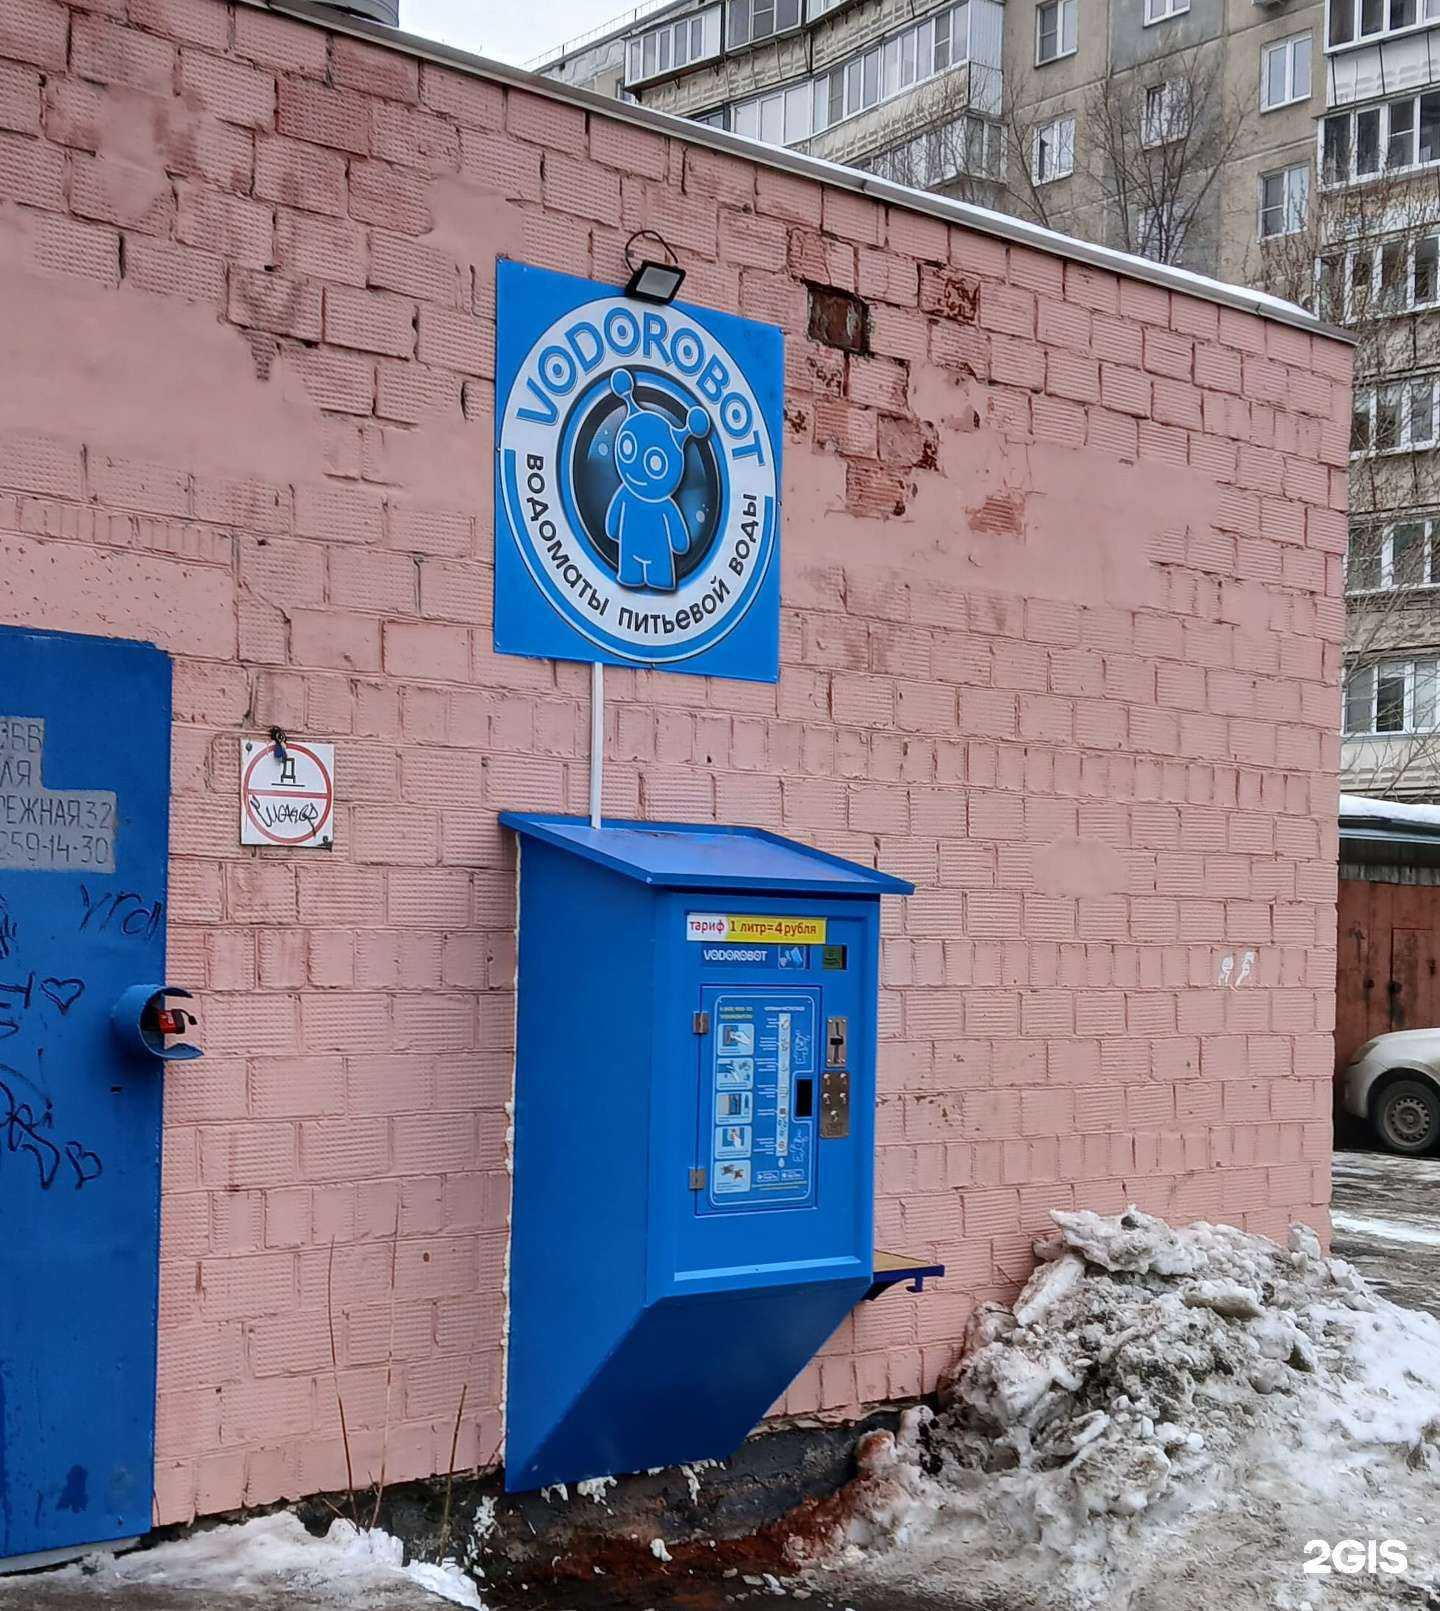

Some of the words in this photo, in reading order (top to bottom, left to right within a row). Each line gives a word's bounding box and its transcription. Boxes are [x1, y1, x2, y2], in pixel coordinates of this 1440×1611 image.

[516, 306, 766, 467] VODOROBOT
[689, 920, 727, 935] тариф
[730, 920, 736, 932] 1
